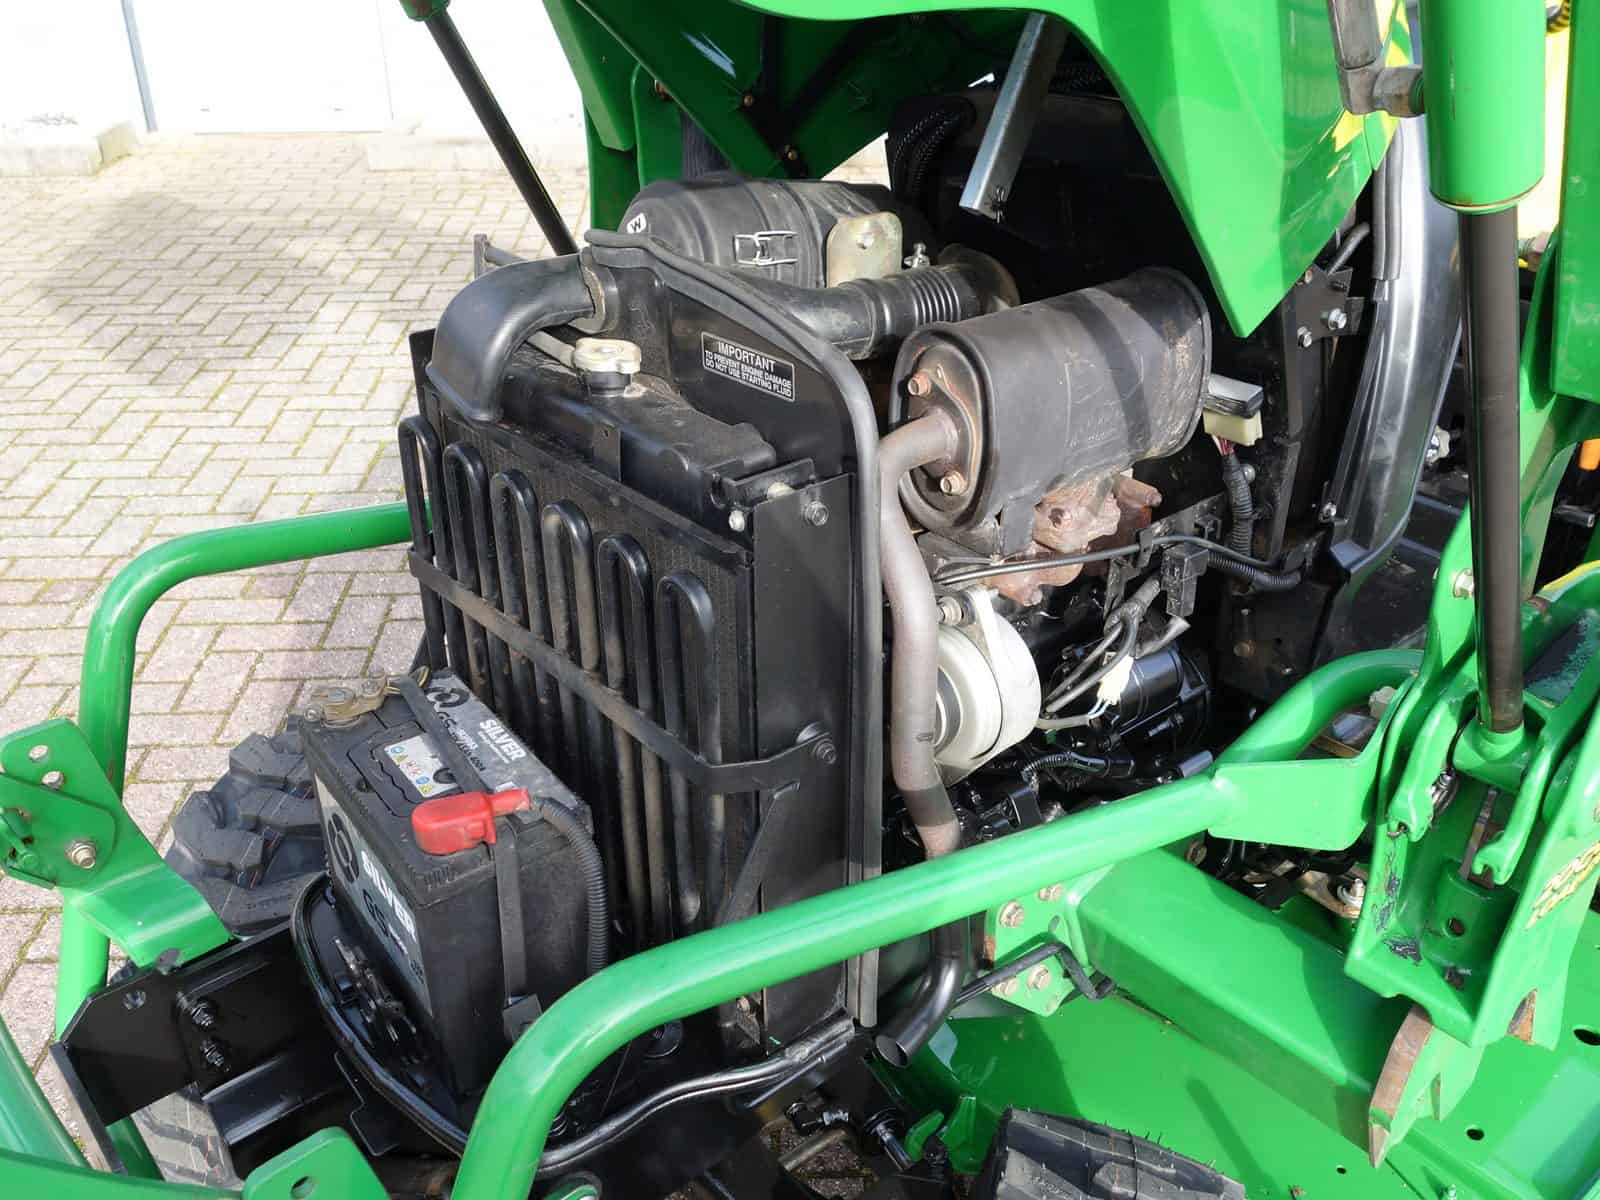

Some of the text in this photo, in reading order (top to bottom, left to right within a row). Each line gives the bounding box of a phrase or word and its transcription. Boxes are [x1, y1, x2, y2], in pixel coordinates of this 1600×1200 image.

[705, 350, 792, 389] TO PREVENT ENGINE DAMAGE
[718, 341, 776, 373] IMPORTANT
[705, 358, 792, 397] DO NOT USE STARTING FLUID
[480, 719, 527, 761] SILVER
[361, 850, 418, 943] SILVER
